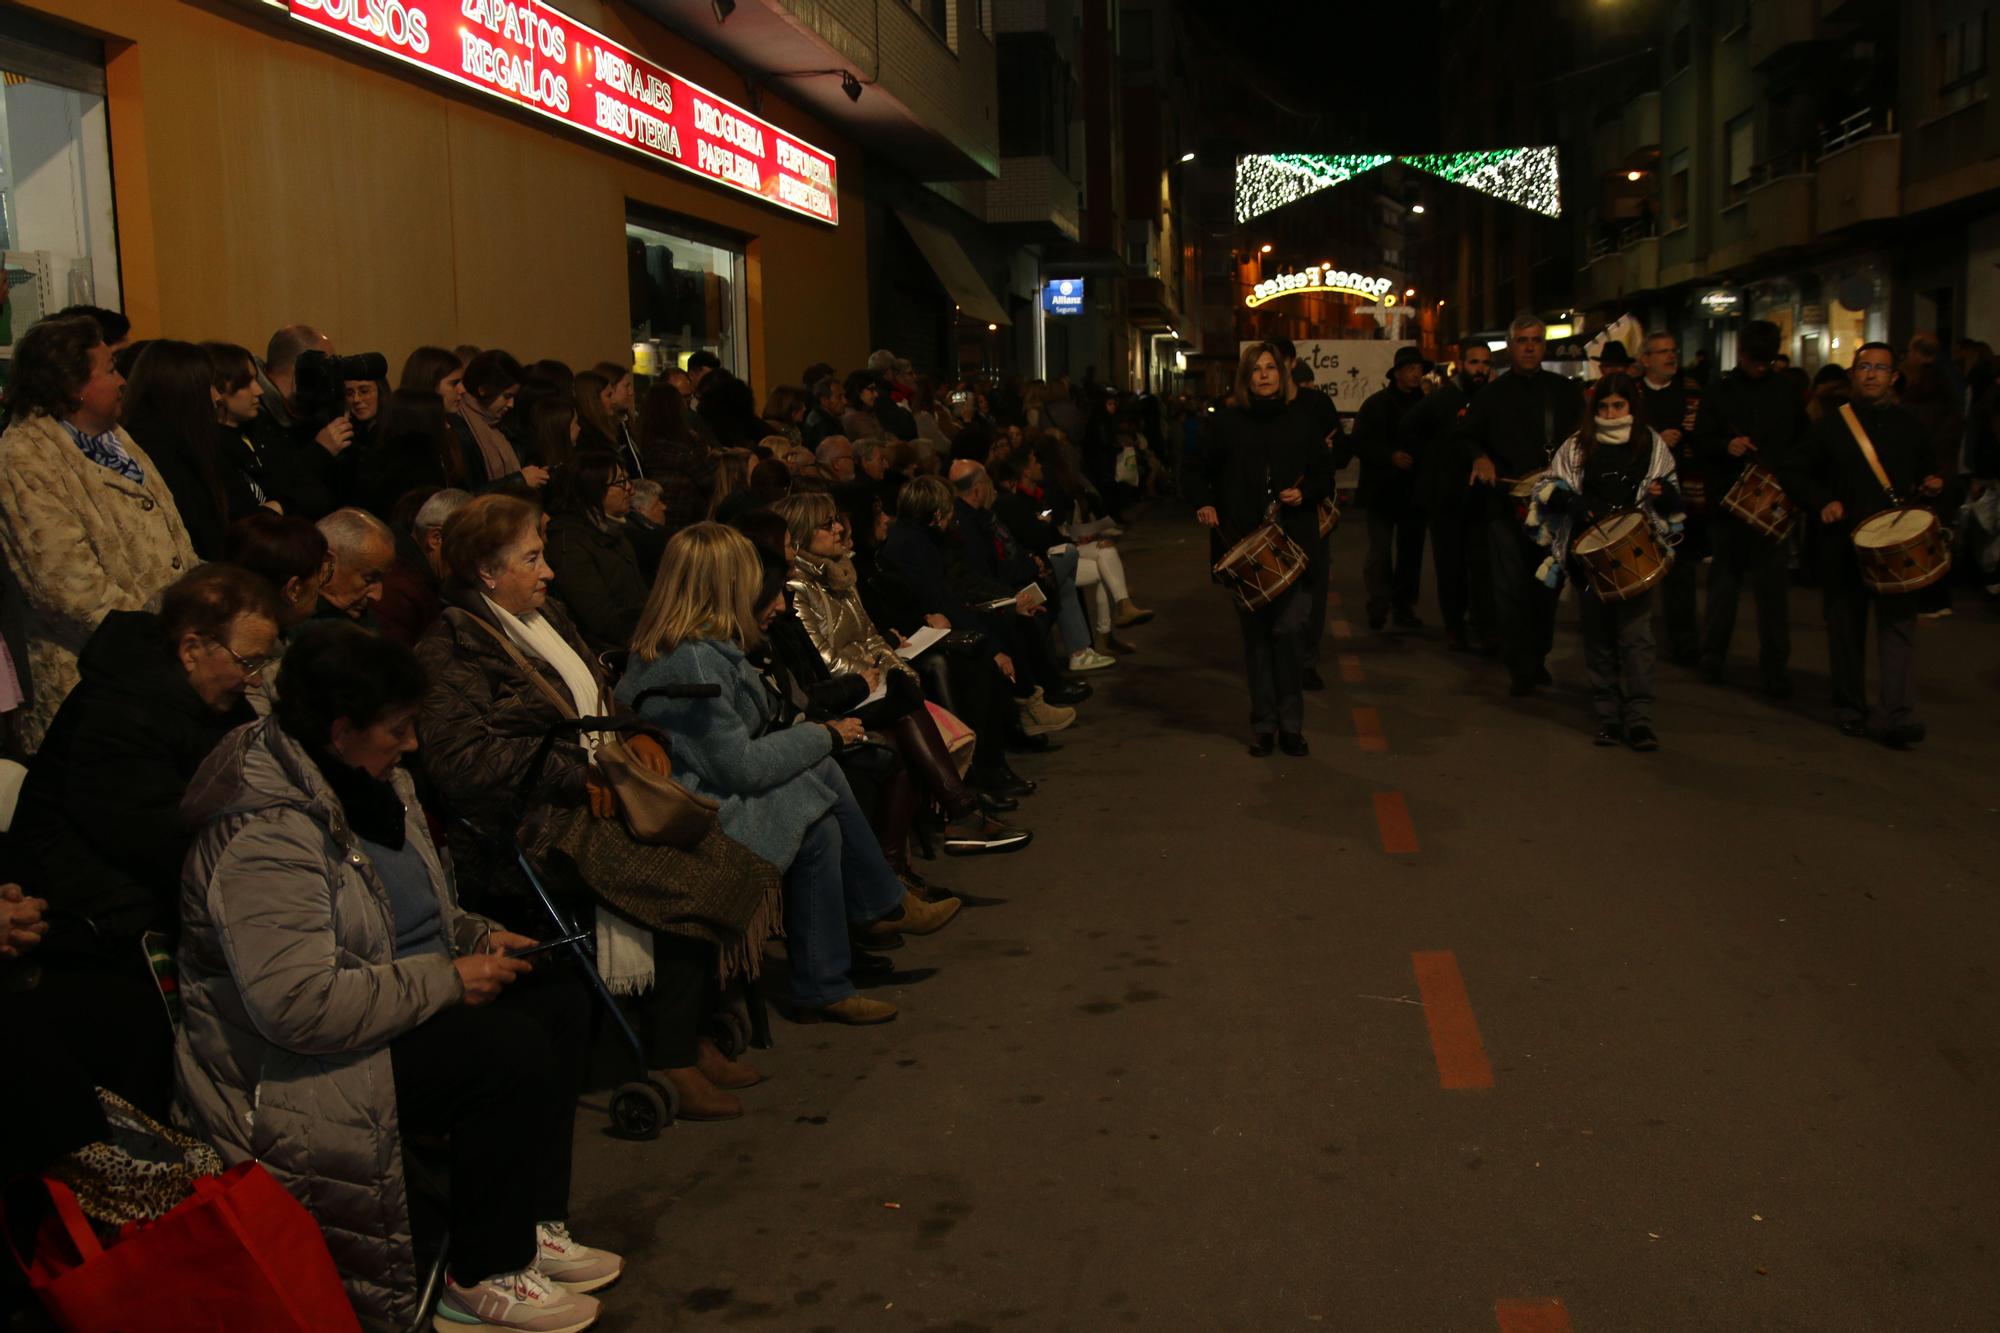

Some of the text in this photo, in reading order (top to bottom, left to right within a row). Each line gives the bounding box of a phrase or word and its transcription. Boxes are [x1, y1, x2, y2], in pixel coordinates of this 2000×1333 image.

[295, 0, 429, 54] LSOS
[462, 28, 570, 113] REGALOS
[594, 46, 672, 115] MENAJES
[595, 92, 682, 158] BISUTERIA
[694, 98, 765, 158] DROGUERIA
[697, 139, 761, 190] PAPELERIA
[776, 138, 831, 188] PERFUMERIA
[1052, 296, 1081, 304] Allianz
